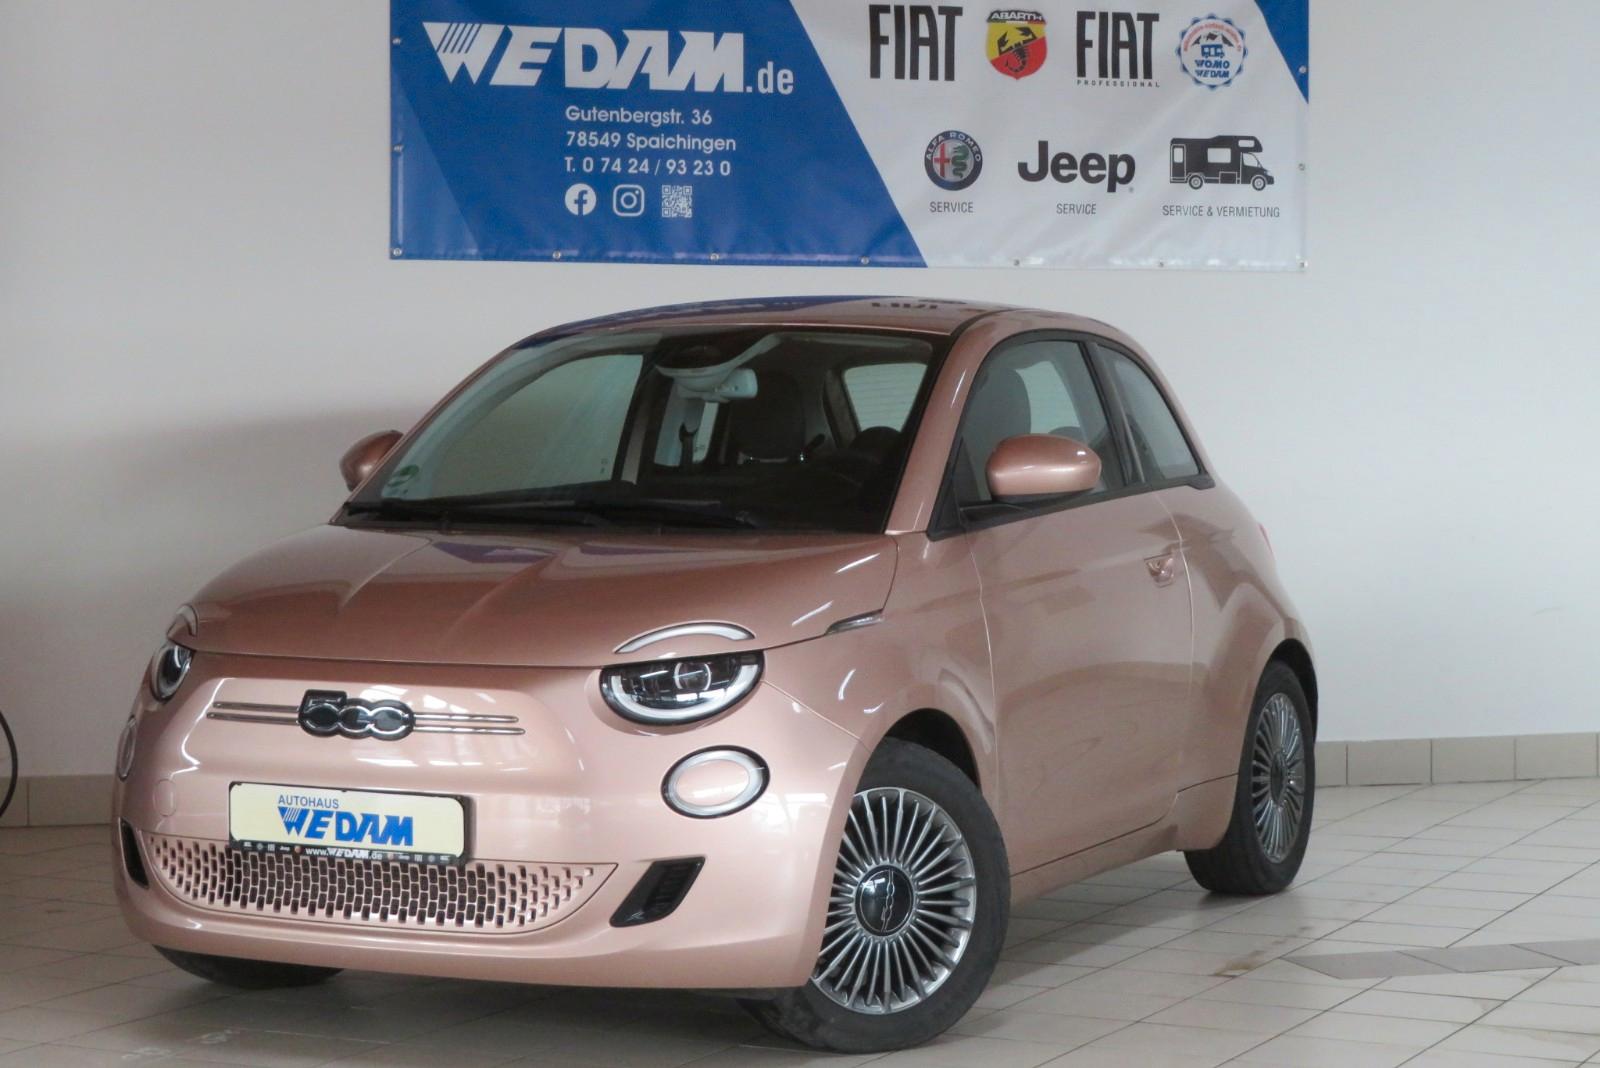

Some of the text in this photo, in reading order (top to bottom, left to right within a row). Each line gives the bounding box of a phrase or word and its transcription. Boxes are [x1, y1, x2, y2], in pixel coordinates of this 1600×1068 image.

[991, 11, 1042, 21] ABARTH
[869, 4, 963, 81] FIAT
[1076, 11, 1160, 80] FIAT
[1195, 59, 1230, 69] WOMO
[1195, 69, 1230, 78] WEDAM
[1076, 79, 1160, 88] PROFESSIONAL
[565, 105, 713, 127] Gutenbergstr. 36
[566, 131, 736, 154] 78549 Spaichingen
[926, 131, 982, 162] ALFA ROMEO
[564, 156, 576, 173] T.
[600, 157, 622, 174] 74
[627, 158, 650, 174] 24
[666, 159, 687, 175] 93
[693, 160, 714, 176] 23
[720, 160, 731, 176] 0
[1017, 140, 1136, 194] Jeep
[929, 201, 974, 213] SERVICE
[1056, 203, 1097, 215] SERVICE
[1162, 204, 1281, 218] SERVICE & VERMIETUNG
[299, 690, 415, 741] 500
[278, 794, 340, 809] AUTOHAUS
[277, 805, 414, 847] WEDAM
[305, 847, 383, 860] www.WEDAM.de
